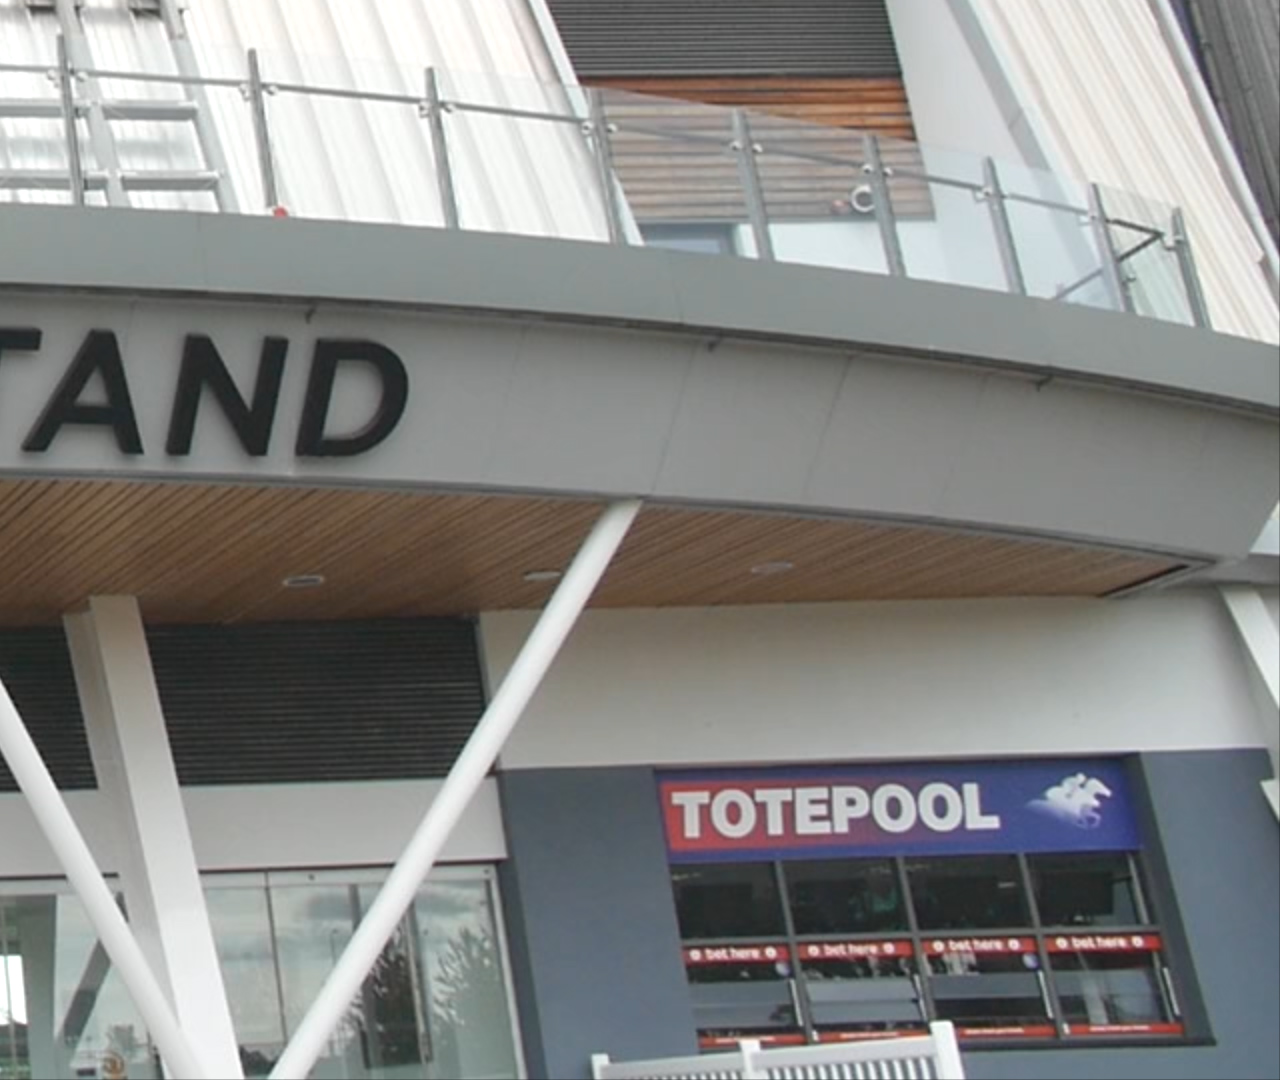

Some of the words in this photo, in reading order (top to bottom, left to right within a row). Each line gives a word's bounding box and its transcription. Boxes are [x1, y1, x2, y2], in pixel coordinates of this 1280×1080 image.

[671, 783, 1001, 839] TOTEPOOL
[948, 940, 971, 952] bet
[973, 939, 1003, 951] here
[1072, 937, 1095, 949] bet
[1096, 936, 1127, 948] here
[705, 948, 728, 960] bet
[730, 947, 761, 959] here
[823, 944, 846, 956] bet
[848, 943, 878, 955] here
